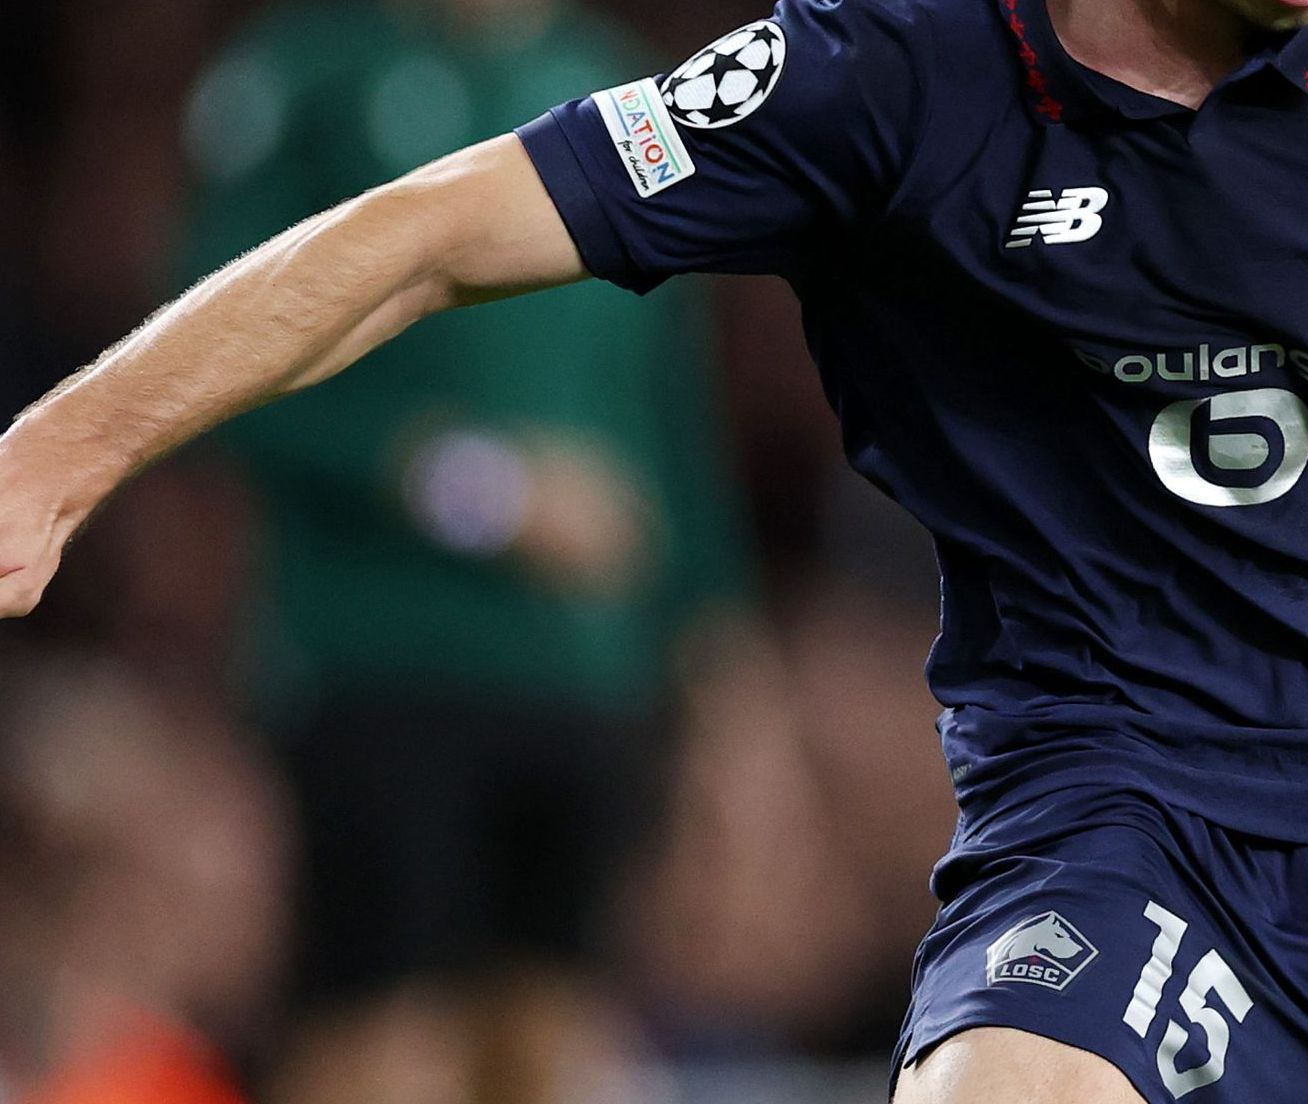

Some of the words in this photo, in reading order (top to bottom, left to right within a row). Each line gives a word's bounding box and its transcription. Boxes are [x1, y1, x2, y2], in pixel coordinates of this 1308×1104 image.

[618, 139, 632, 152] for
[629, 156, 649, 190] children
[1000, 963, 1061, 983] LOSC
[1122, 899, 1254, 1100] 15
